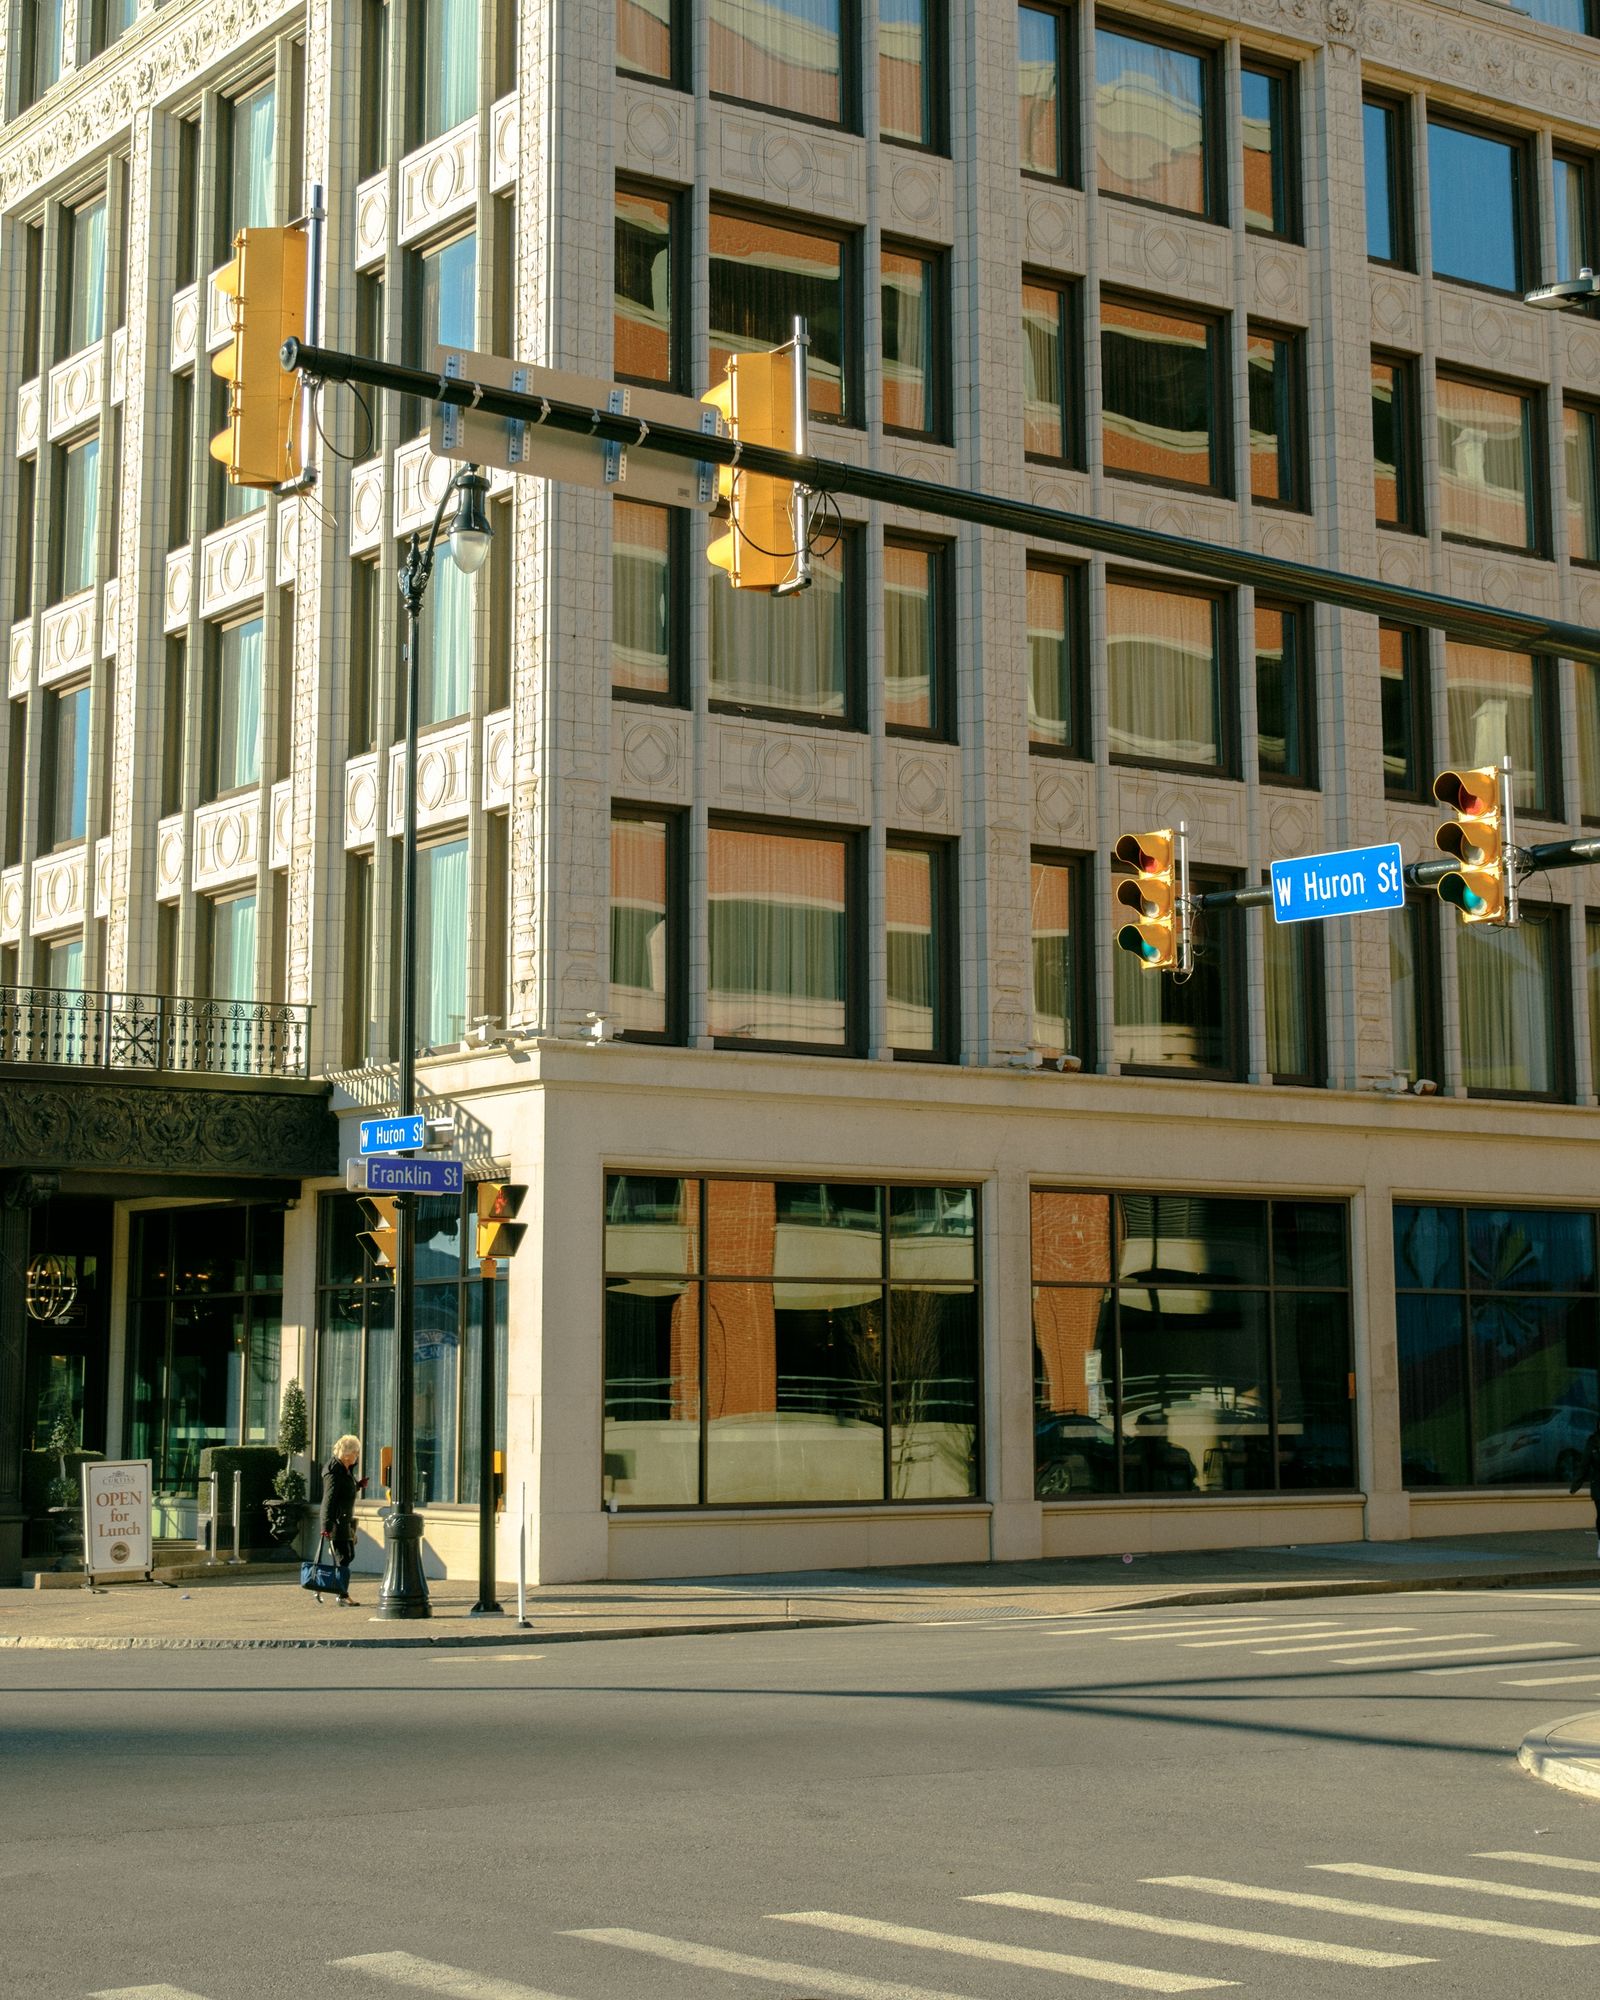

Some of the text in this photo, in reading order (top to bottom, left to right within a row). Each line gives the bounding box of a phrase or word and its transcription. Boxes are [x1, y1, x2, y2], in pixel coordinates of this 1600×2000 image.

[1276, 861, 1399, 907] W Huron St
[361, 1122, 423, 1148] W Huron St
[372, 1164, 458, 1187] Franklin St
[96, 1491, 142, 1507] OPEN
[110, 1508, 130, 1522] for
[98, 1522, 141, 1537] Lunch
